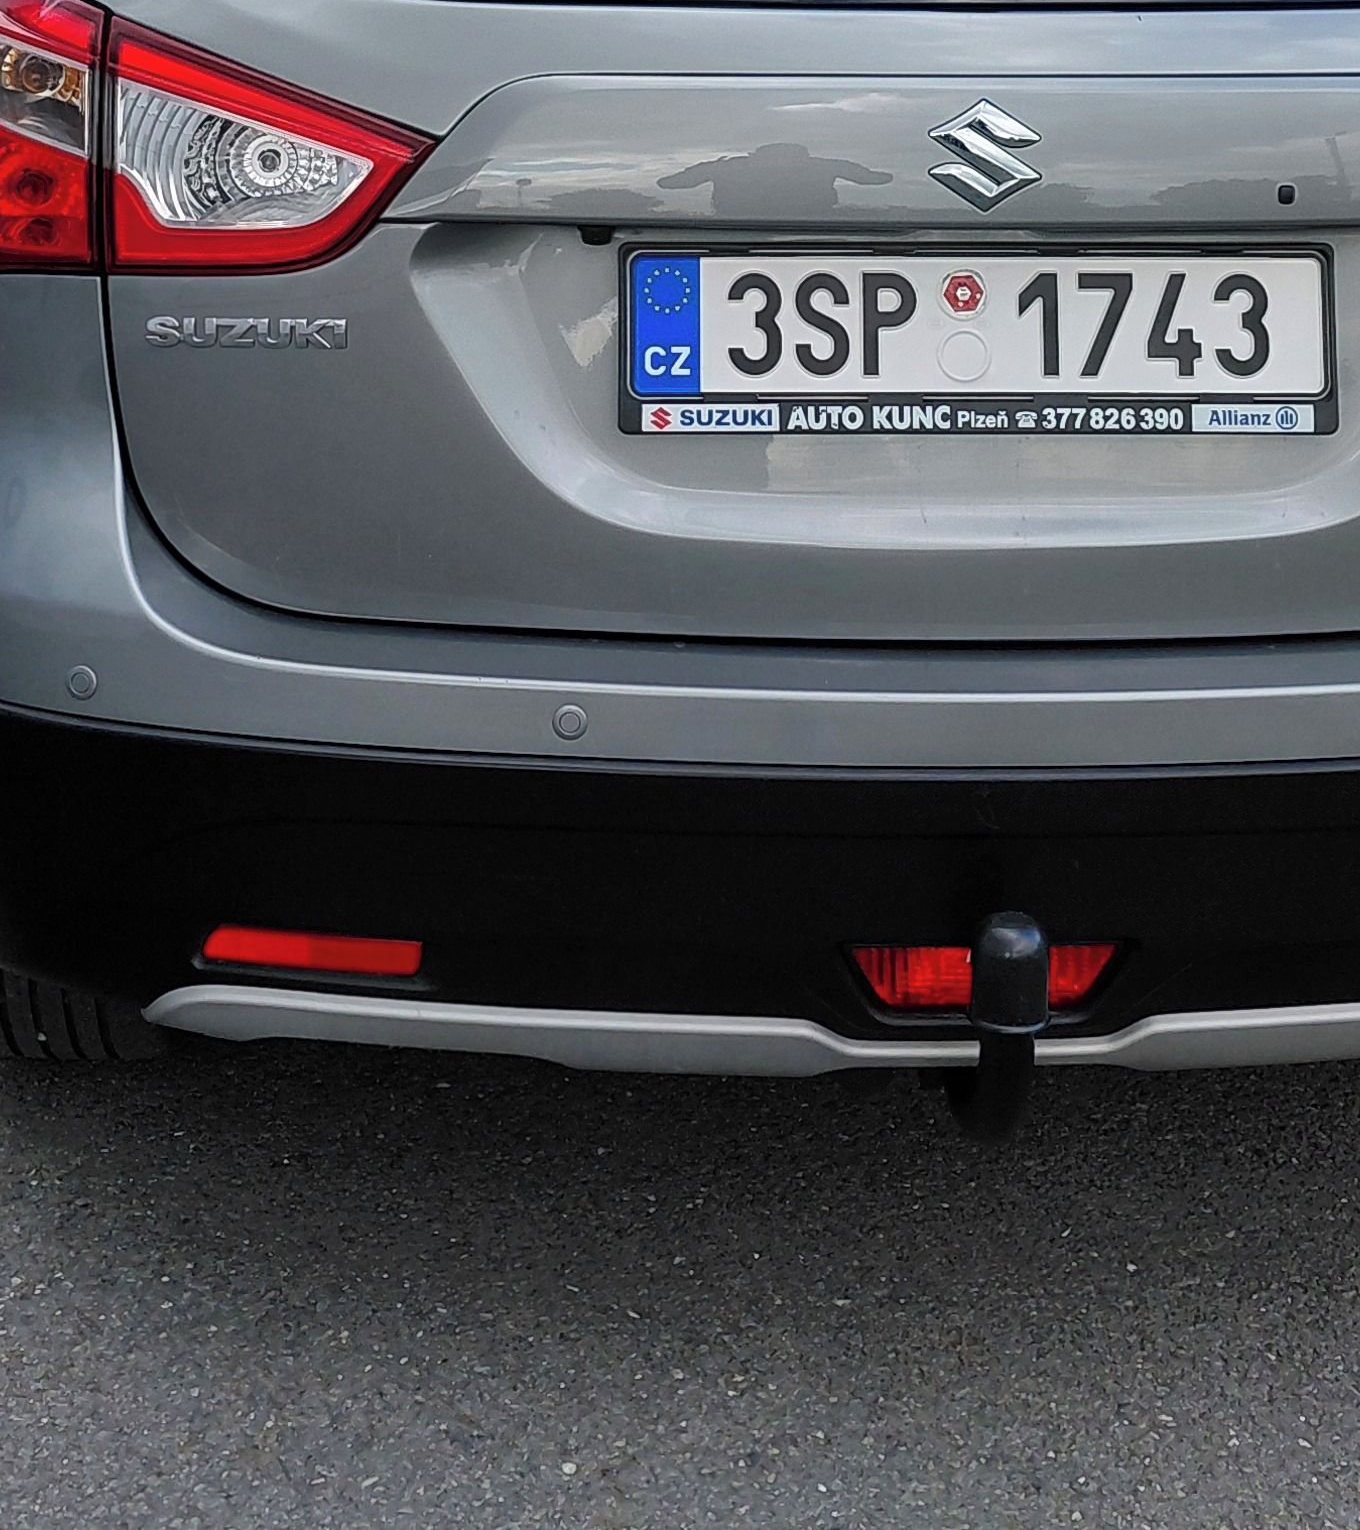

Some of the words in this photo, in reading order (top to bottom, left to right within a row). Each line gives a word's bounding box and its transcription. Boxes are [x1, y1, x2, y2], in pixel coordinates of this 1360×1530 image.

[144, 315, 349, 350] SUZUKI
[727, 272, 918, 376] 3SP
[1017, 272, 1271, 377] 1743
[644, 346, 691, 376] CZ
[679, 409, 773, 427] SUZUKI
[786, 406, 865, 430] AUTO
[872, 405, 952, 430] KUNC
[956, 410, 1009, 429] Plzeň
[1041, 408, 1088, 430] 377
[1089, 408, 1140, 430] 826
[1139, 408, 1185, 430] 390
[1208, 409, 1272, 427] Allianz
